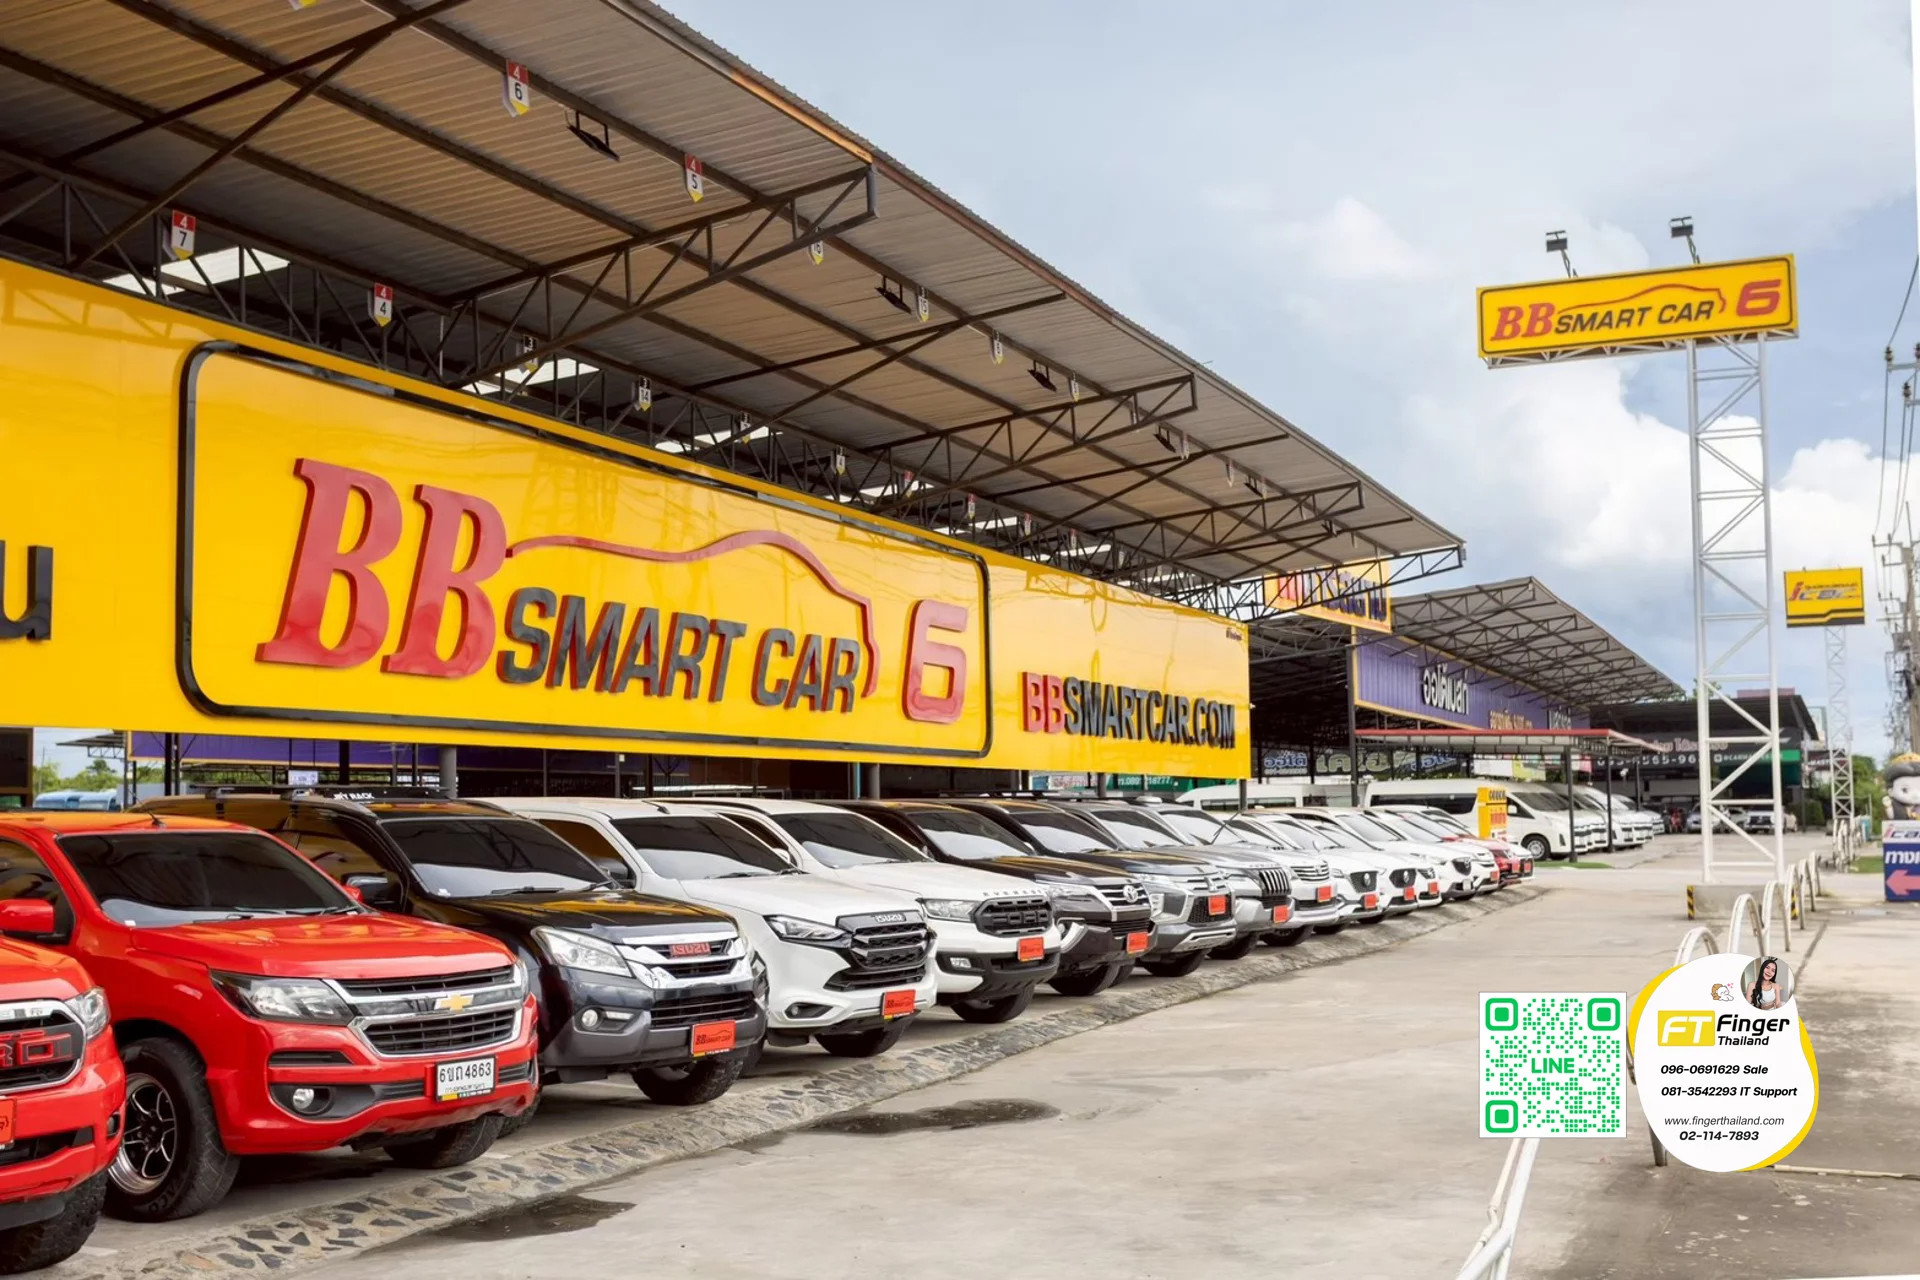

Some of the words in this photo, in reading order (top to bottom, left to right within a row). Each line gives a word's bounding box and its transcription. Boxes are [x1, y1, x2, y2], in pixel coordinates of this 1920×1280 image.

[513, 66, 521, 80] 4
[514, 82, 523, 101] 6
[690, 160, 697, 171] 4
[691, 175, 698, 190] 5
[180, 215, 188, 228] 4
[179, 230, 188, 247] 7
[379, 285, 387, 298] 4
[379, 301, 387, 315] 4
[1490, 302, 1555, 341] BB
[1554, 305, 1652, 334] SMART
[1657, 300, 1715, 325] CAR
[1735, 279, 1782, 316] 6
[255, 457, 508, 679] BB
[497, 586, 748, 704] SMART
[751, 627, 861, 715] CAR
[902, 599, 970, 724] 6
[1022, 671, 1236, 750] BBSMARTCAR.COM
[671, 942, 711, 957] ISUZU
[465, 1062, 492, 1079] 4863
